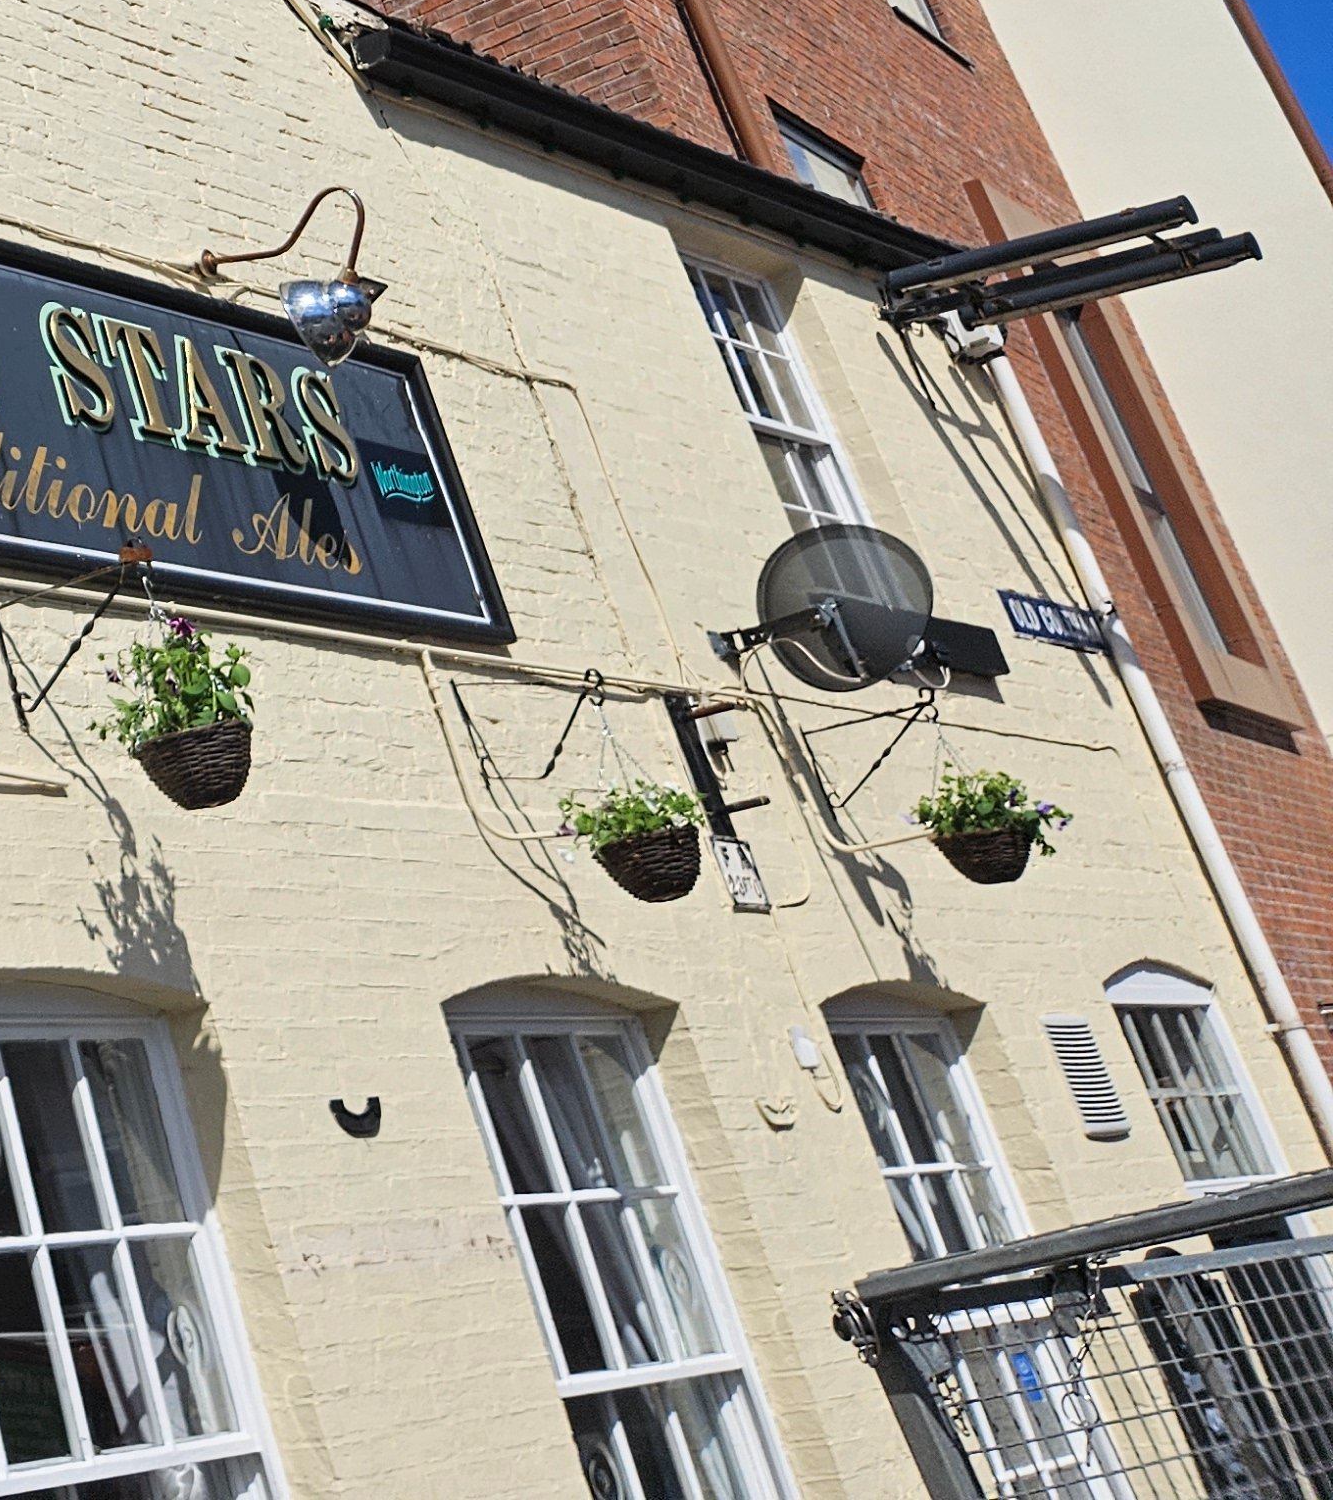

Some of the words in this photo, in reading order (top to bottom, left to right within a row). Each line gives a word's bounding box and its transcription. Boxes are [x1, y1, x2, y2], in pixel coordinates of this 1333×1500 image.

[39, 301, 358, 486] STARS
[232, 491, 363, 576] Ales
[1008, 598, 1041, 631] OLD
